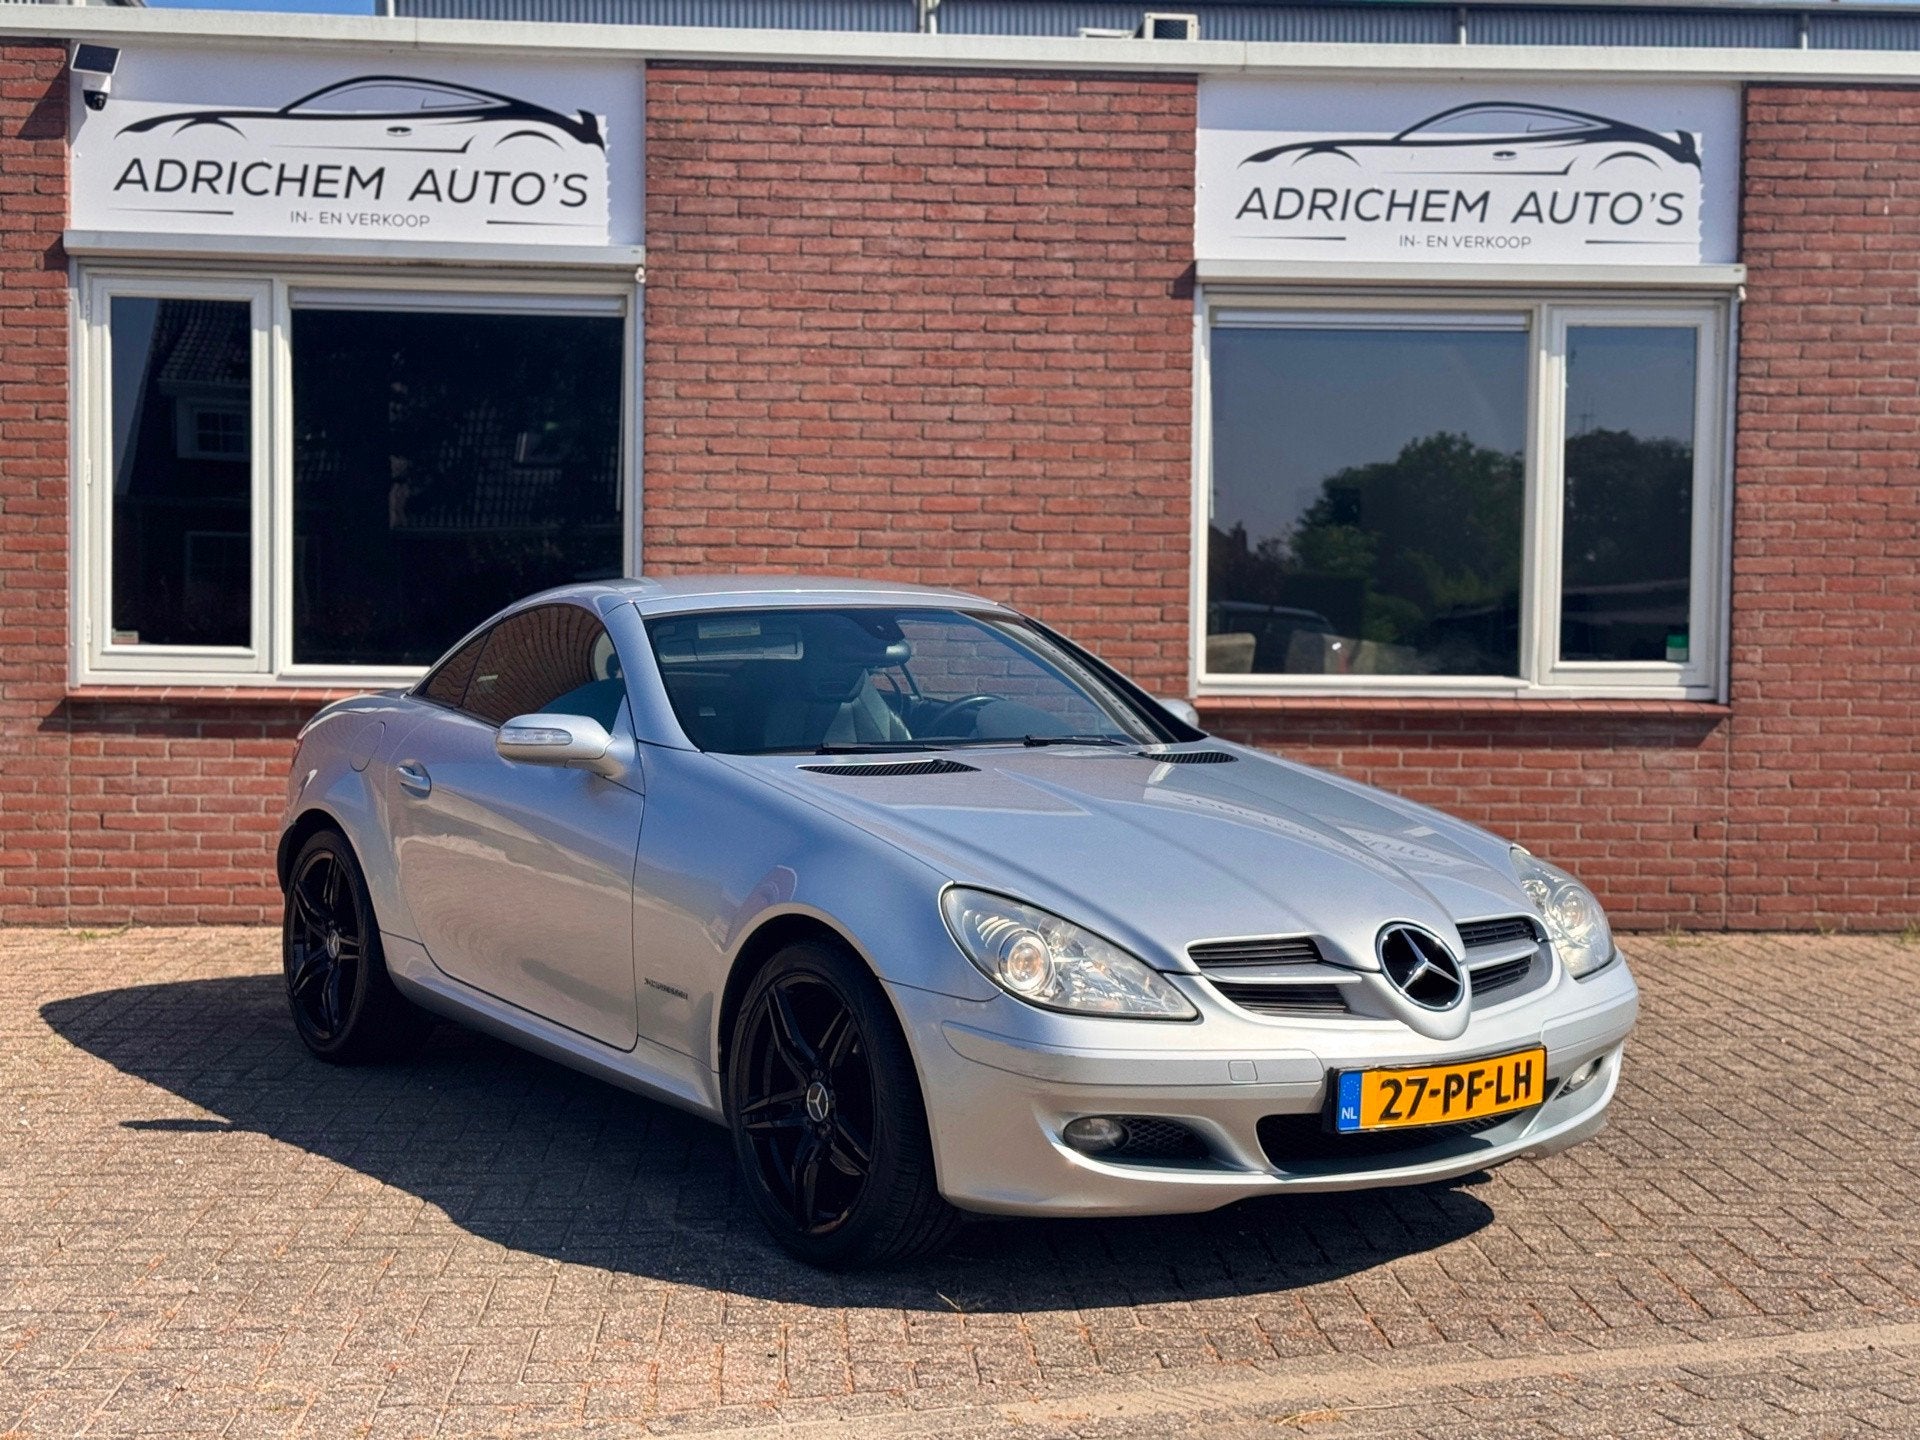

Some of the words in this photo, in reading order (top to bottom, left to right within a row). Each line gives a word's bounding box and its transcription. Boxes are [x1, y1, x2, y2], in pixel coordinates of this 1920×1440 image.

[113, 157, 386, 200] ADRICHEM
[408, 168, 589, 207] AUTO'S
[290, 210, 314, 224] IN-
[319, 211, 343, 225] EN
[346, 212, 431, 228] VERKOOP
[1235, 187, 1491, 223] ADRICHEM
[1511, 191, 1685, 226] AUTO'S
[1399, 234, 1421, 247] IN-
[1426, 235, 1449, 248] EN
[1452, 235, 1532, 249] VERKOOP
[1378, 1059, 1533, 1121] 27-PF-LH
[1341, 1107, 1358, 1120] NL
